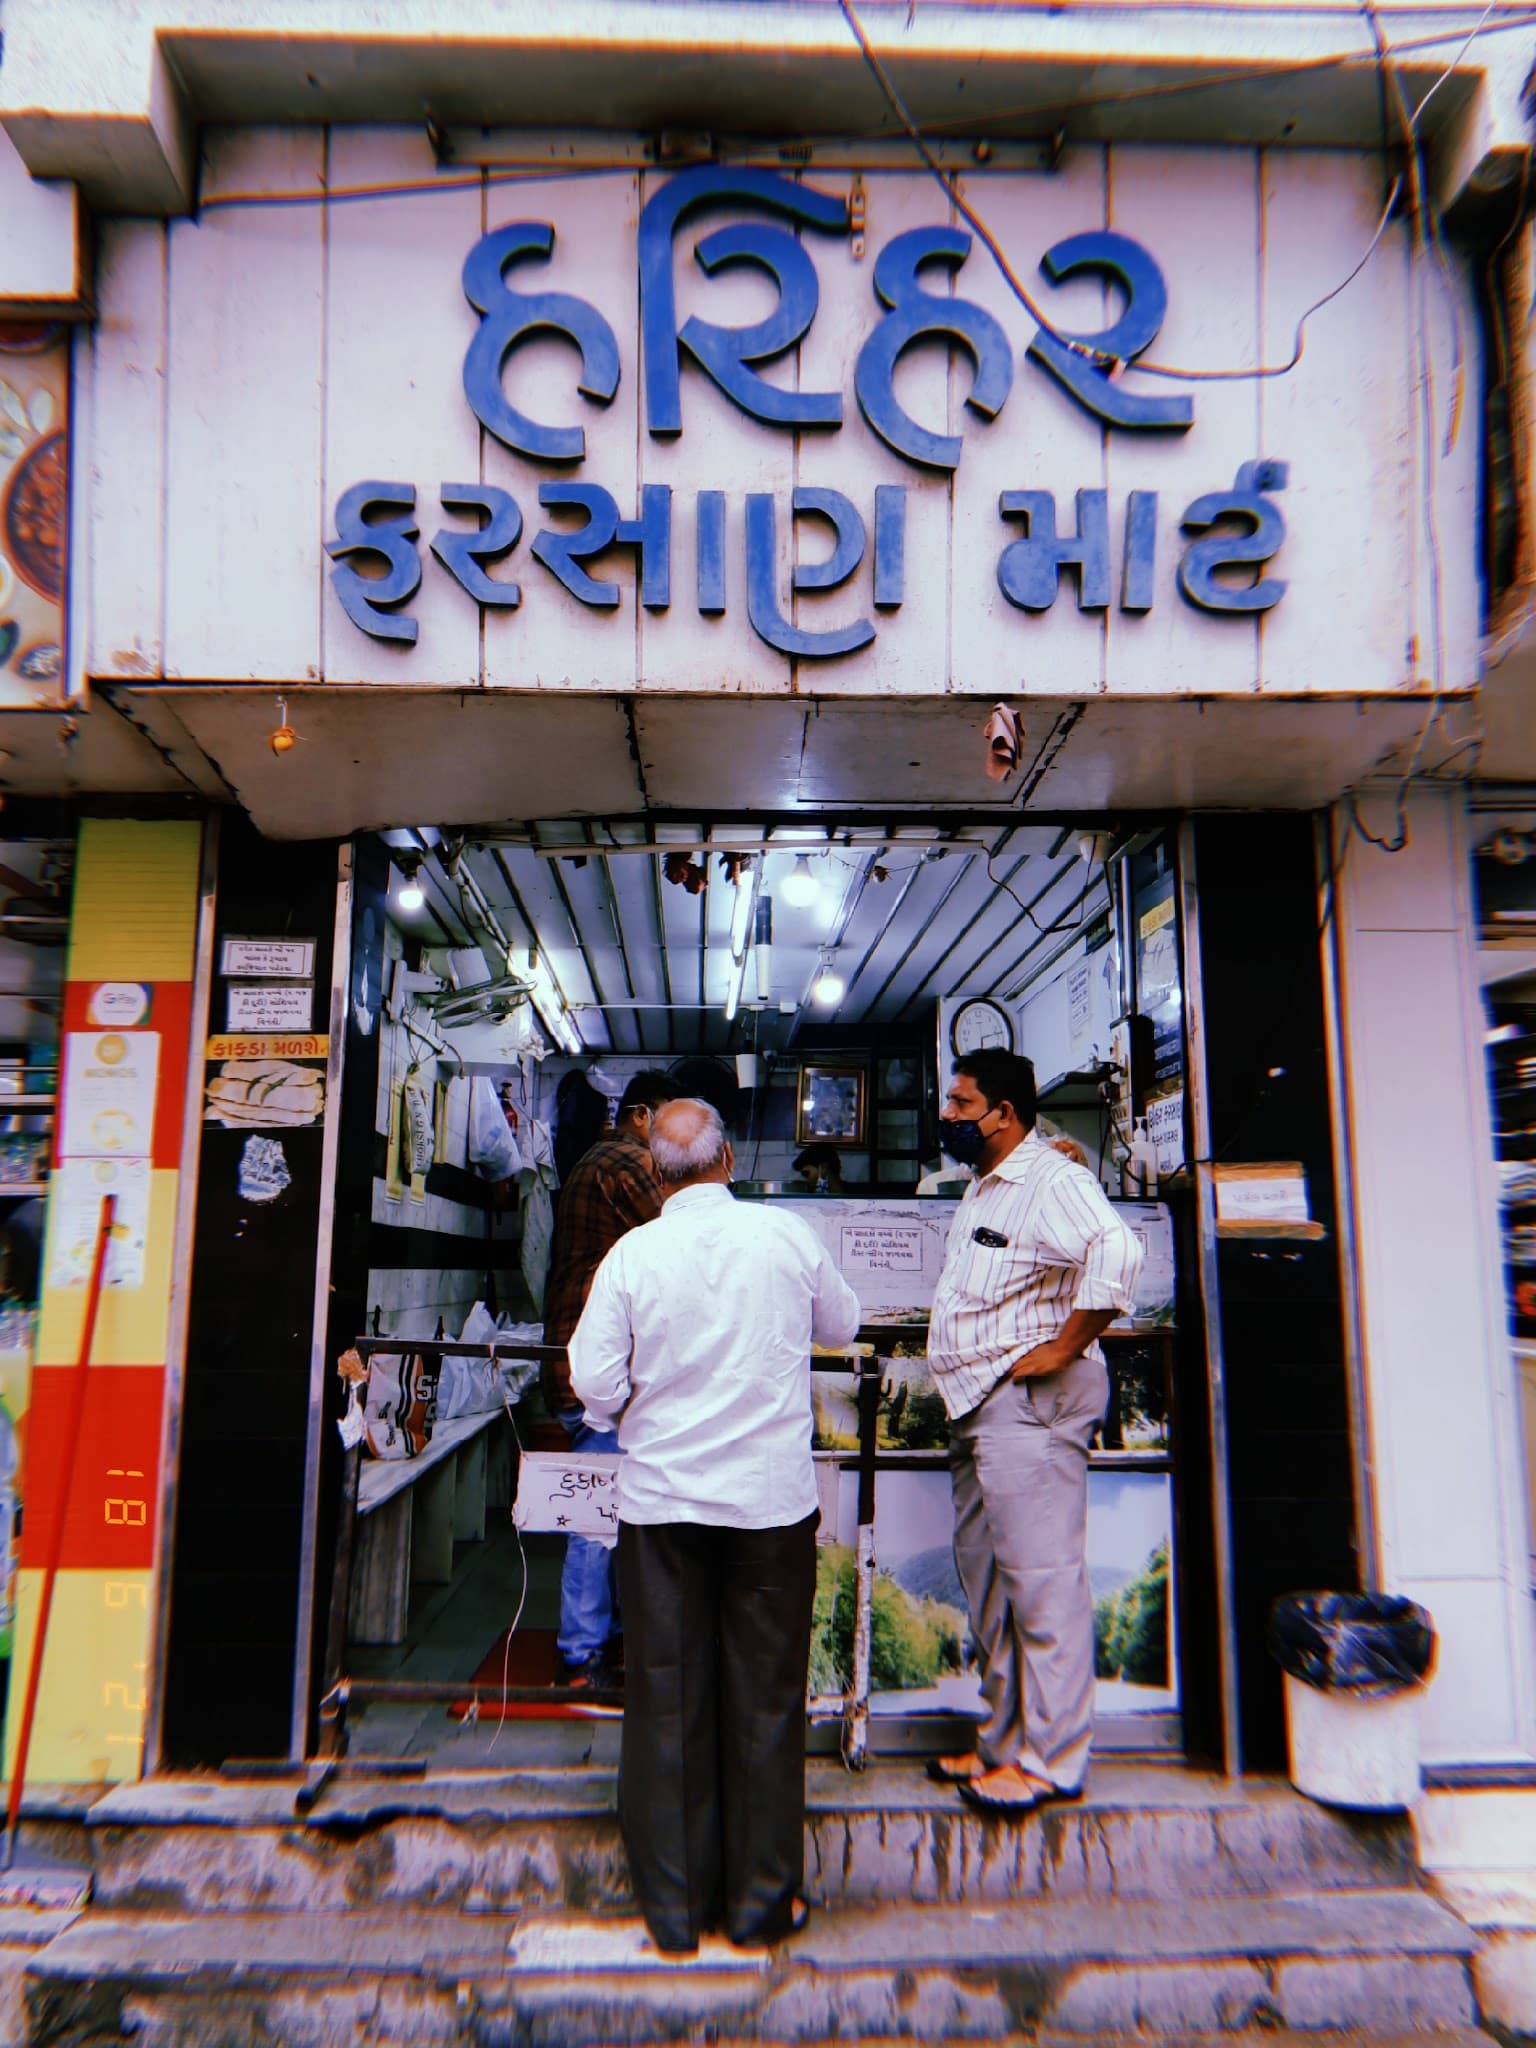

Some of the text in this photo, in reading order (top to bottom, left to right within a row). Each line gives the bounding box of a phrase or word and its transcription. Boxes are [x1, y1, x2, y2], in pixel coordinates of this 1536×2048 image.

[463, 164, 1194, 472] હરિહર
[324, 459, 1288, 661] ફરસાણ માર્ટ
